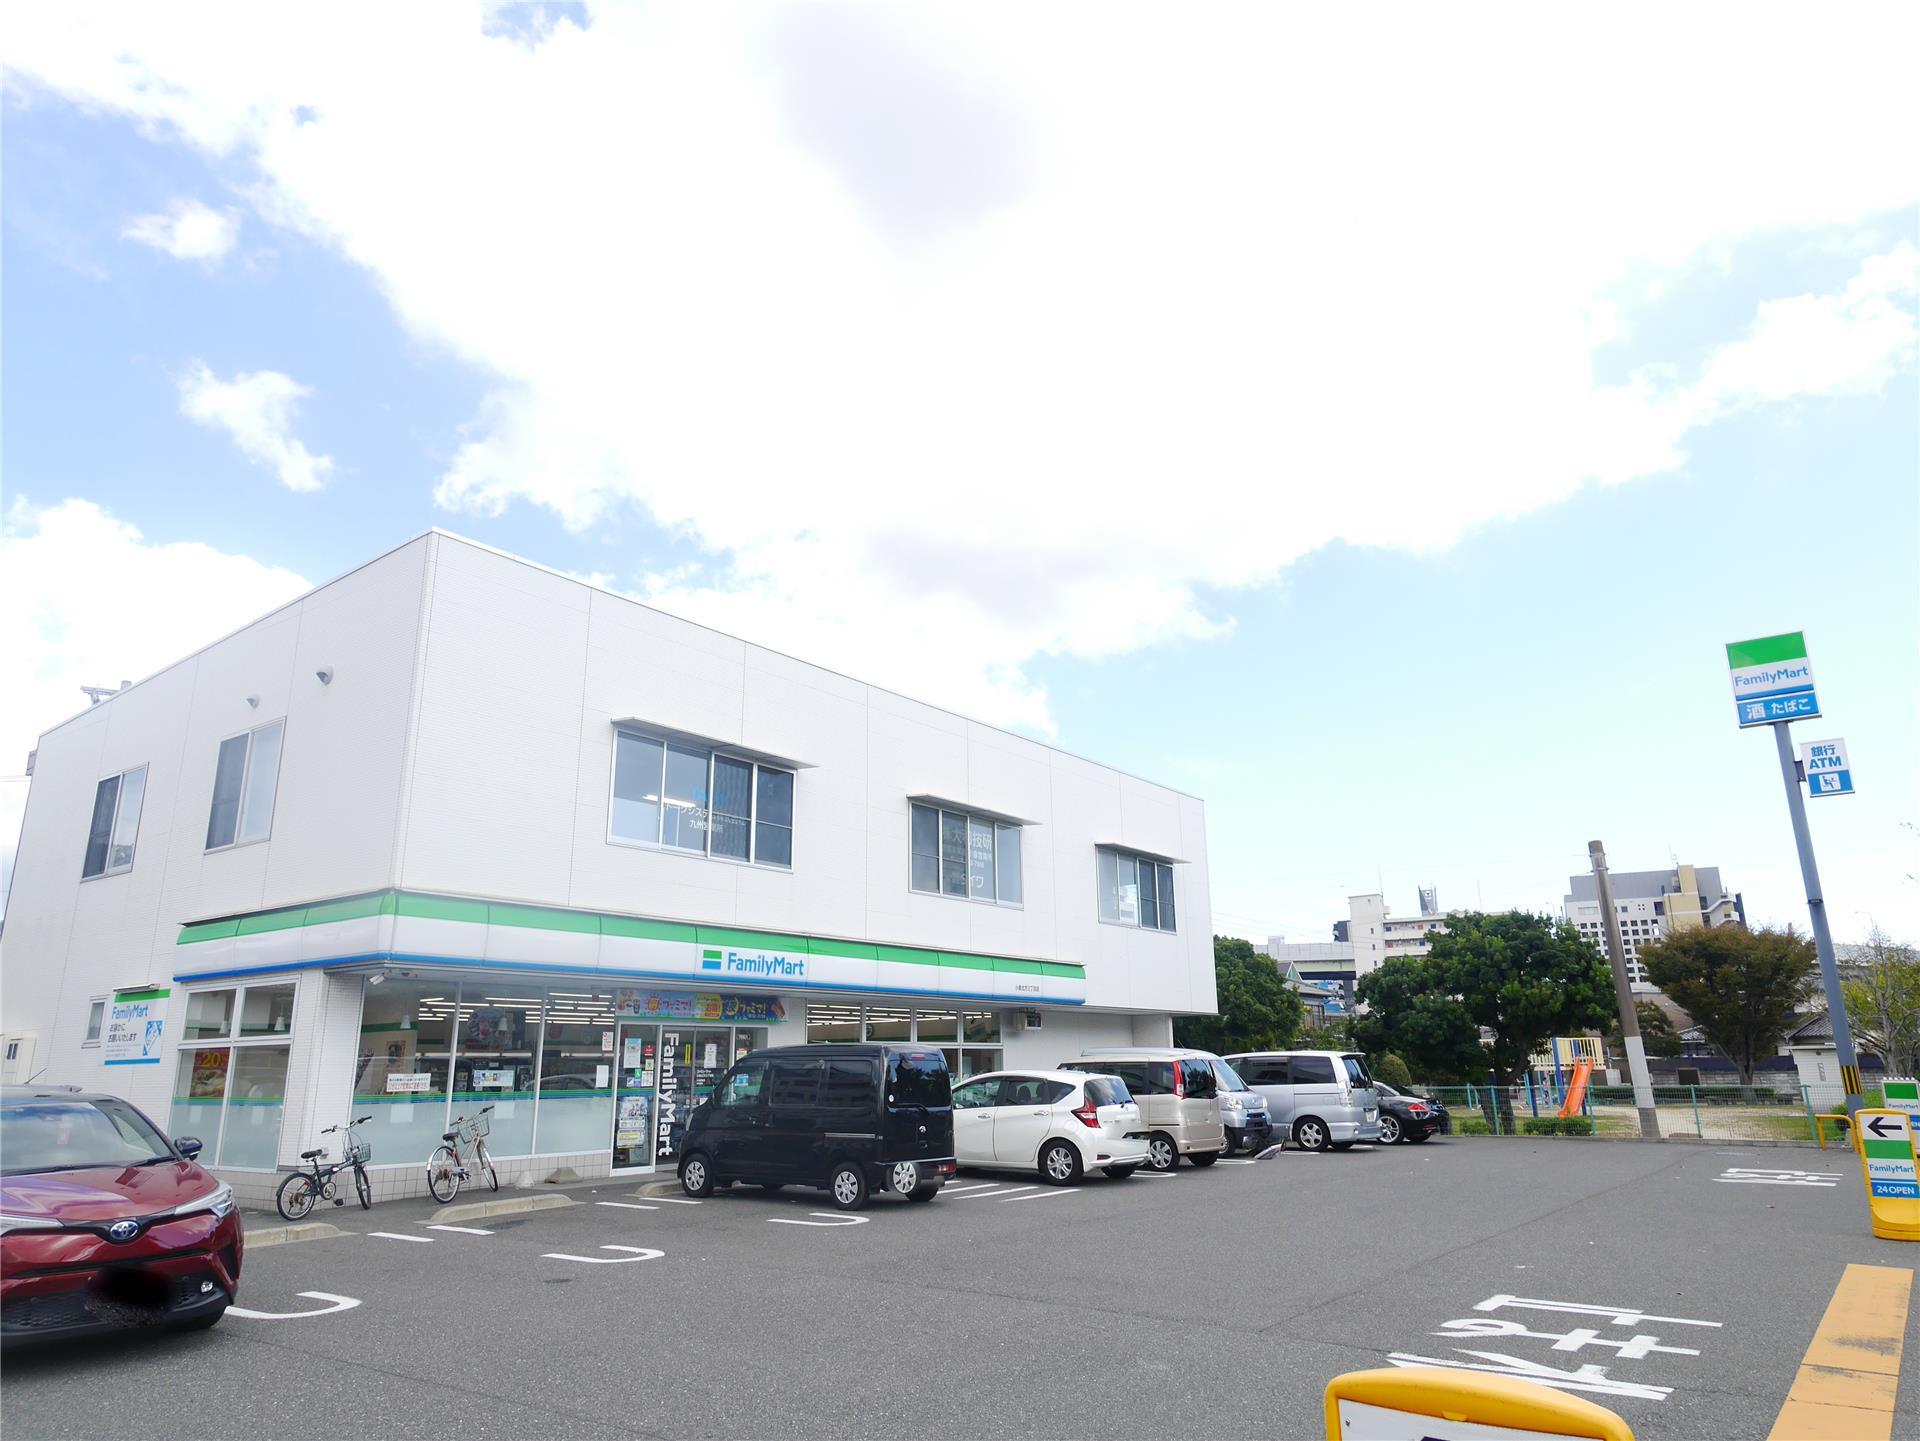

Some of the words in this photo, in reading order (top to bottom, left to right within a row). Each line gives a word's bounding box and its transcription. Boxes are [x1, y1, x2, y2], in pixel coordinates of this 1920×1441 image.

[1735, 666, 1809, 687] FamilyMart
[1747, 703, 1766, 720] 酒
[1771, 698, 1811, 715] たばこ
[1810, 744, 1836, 757] 銀行
[1809, 756, 1842, 770] ATM
[727, 952, 805, 976] FamilyMart
[112, 1004, 148, 1021] FamilyMart
[658, 1032, 679, 1157] FamilyMart
[1869, 1164, 1914, 1174] FamilyMart
